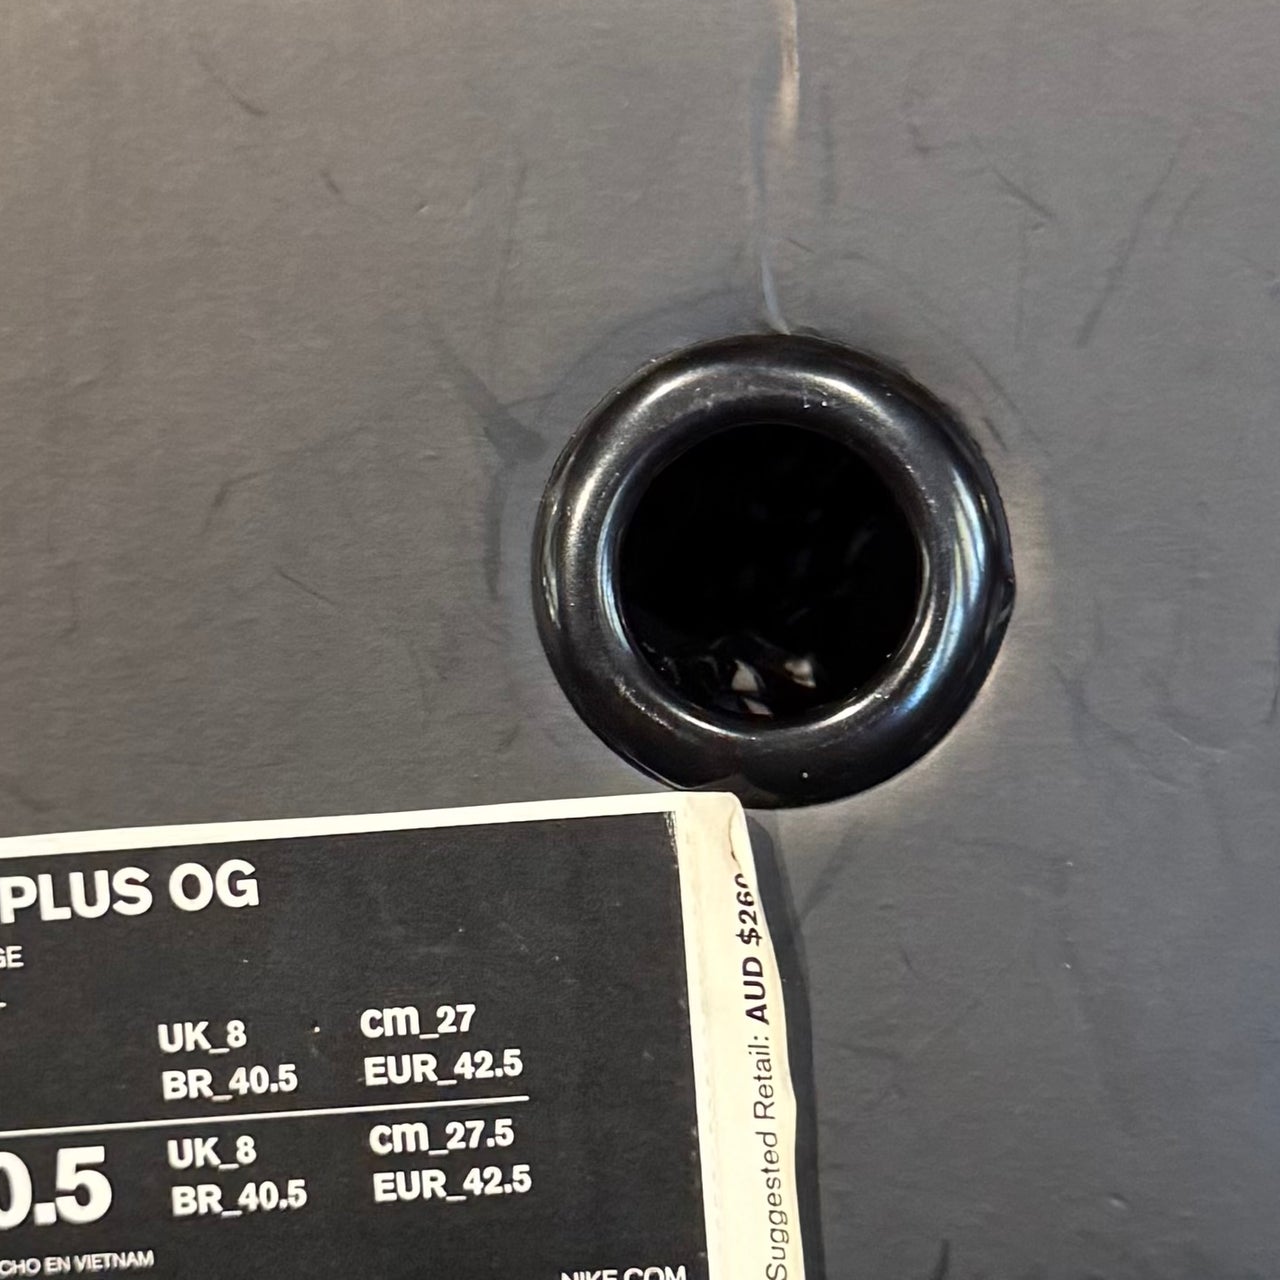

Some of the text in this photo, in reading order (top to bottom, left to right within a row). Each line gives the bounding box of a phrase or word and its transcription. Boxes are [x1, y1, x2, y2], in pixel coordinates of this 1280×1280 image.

[168, 858, 260, 912] OG
[742, 956, 770, 1025] AUD
[157, 1019, 247, 1054] UK_8
[360, 1003, 476, 1040] cm_27
[161, 1063, 298, 1102] BR_40.5
[363, 1048, 523, 1086] EUR_42.5
[747, 1035, 776, 1120] Retail:
[167, 1135, 257, 1170] UK_8
[369, 1118, 515, 1156] cm_27.5
[171, 1179, 308, 1217] BR_40.5
[372, 1164, 532, 1203] EUR_42.5
[43, 1255, 71, 1275] EN
[73, 1249, 154, 1272] VIETNAM
